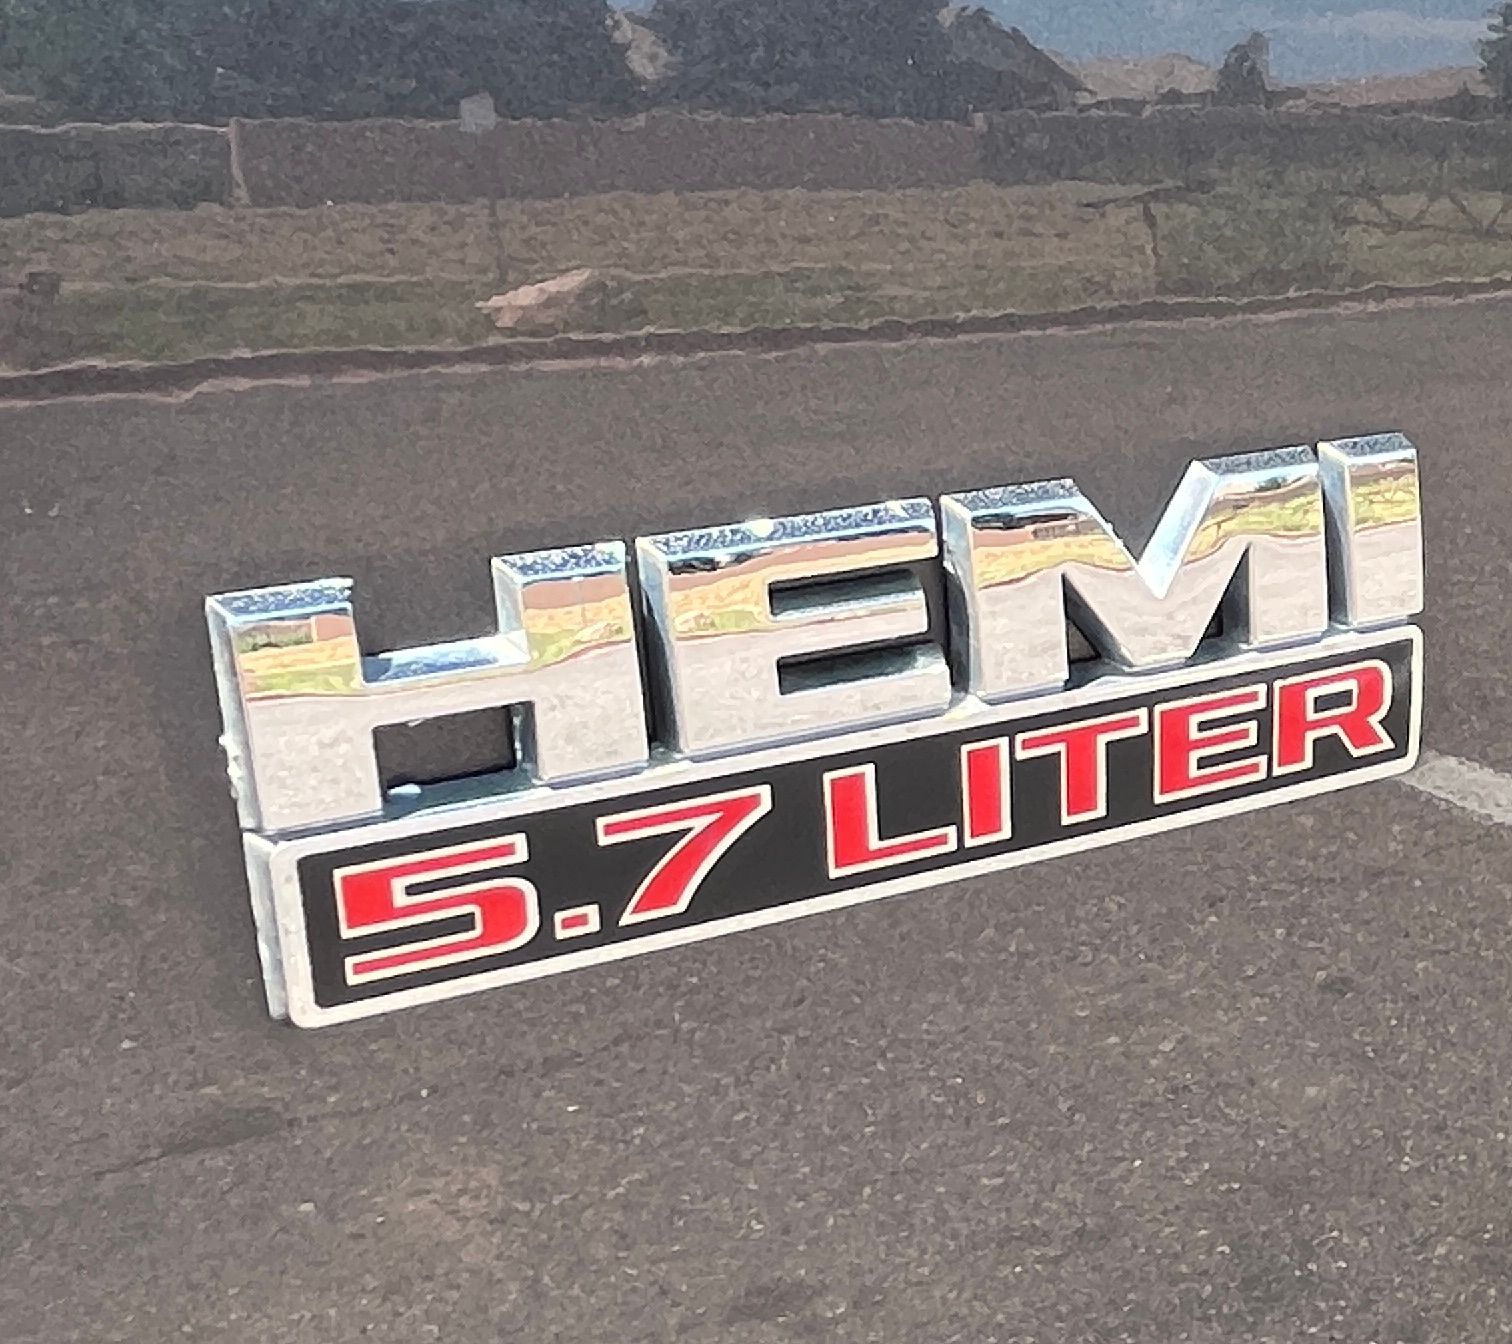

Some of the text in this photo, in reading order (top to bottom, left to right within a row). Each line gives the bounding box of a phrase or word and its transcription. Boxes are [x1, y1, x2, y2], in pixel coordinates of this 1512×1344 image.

[206, 432, 1424, 831] HEMI
[332, 658, 1397, 986] 5.7 LITER
